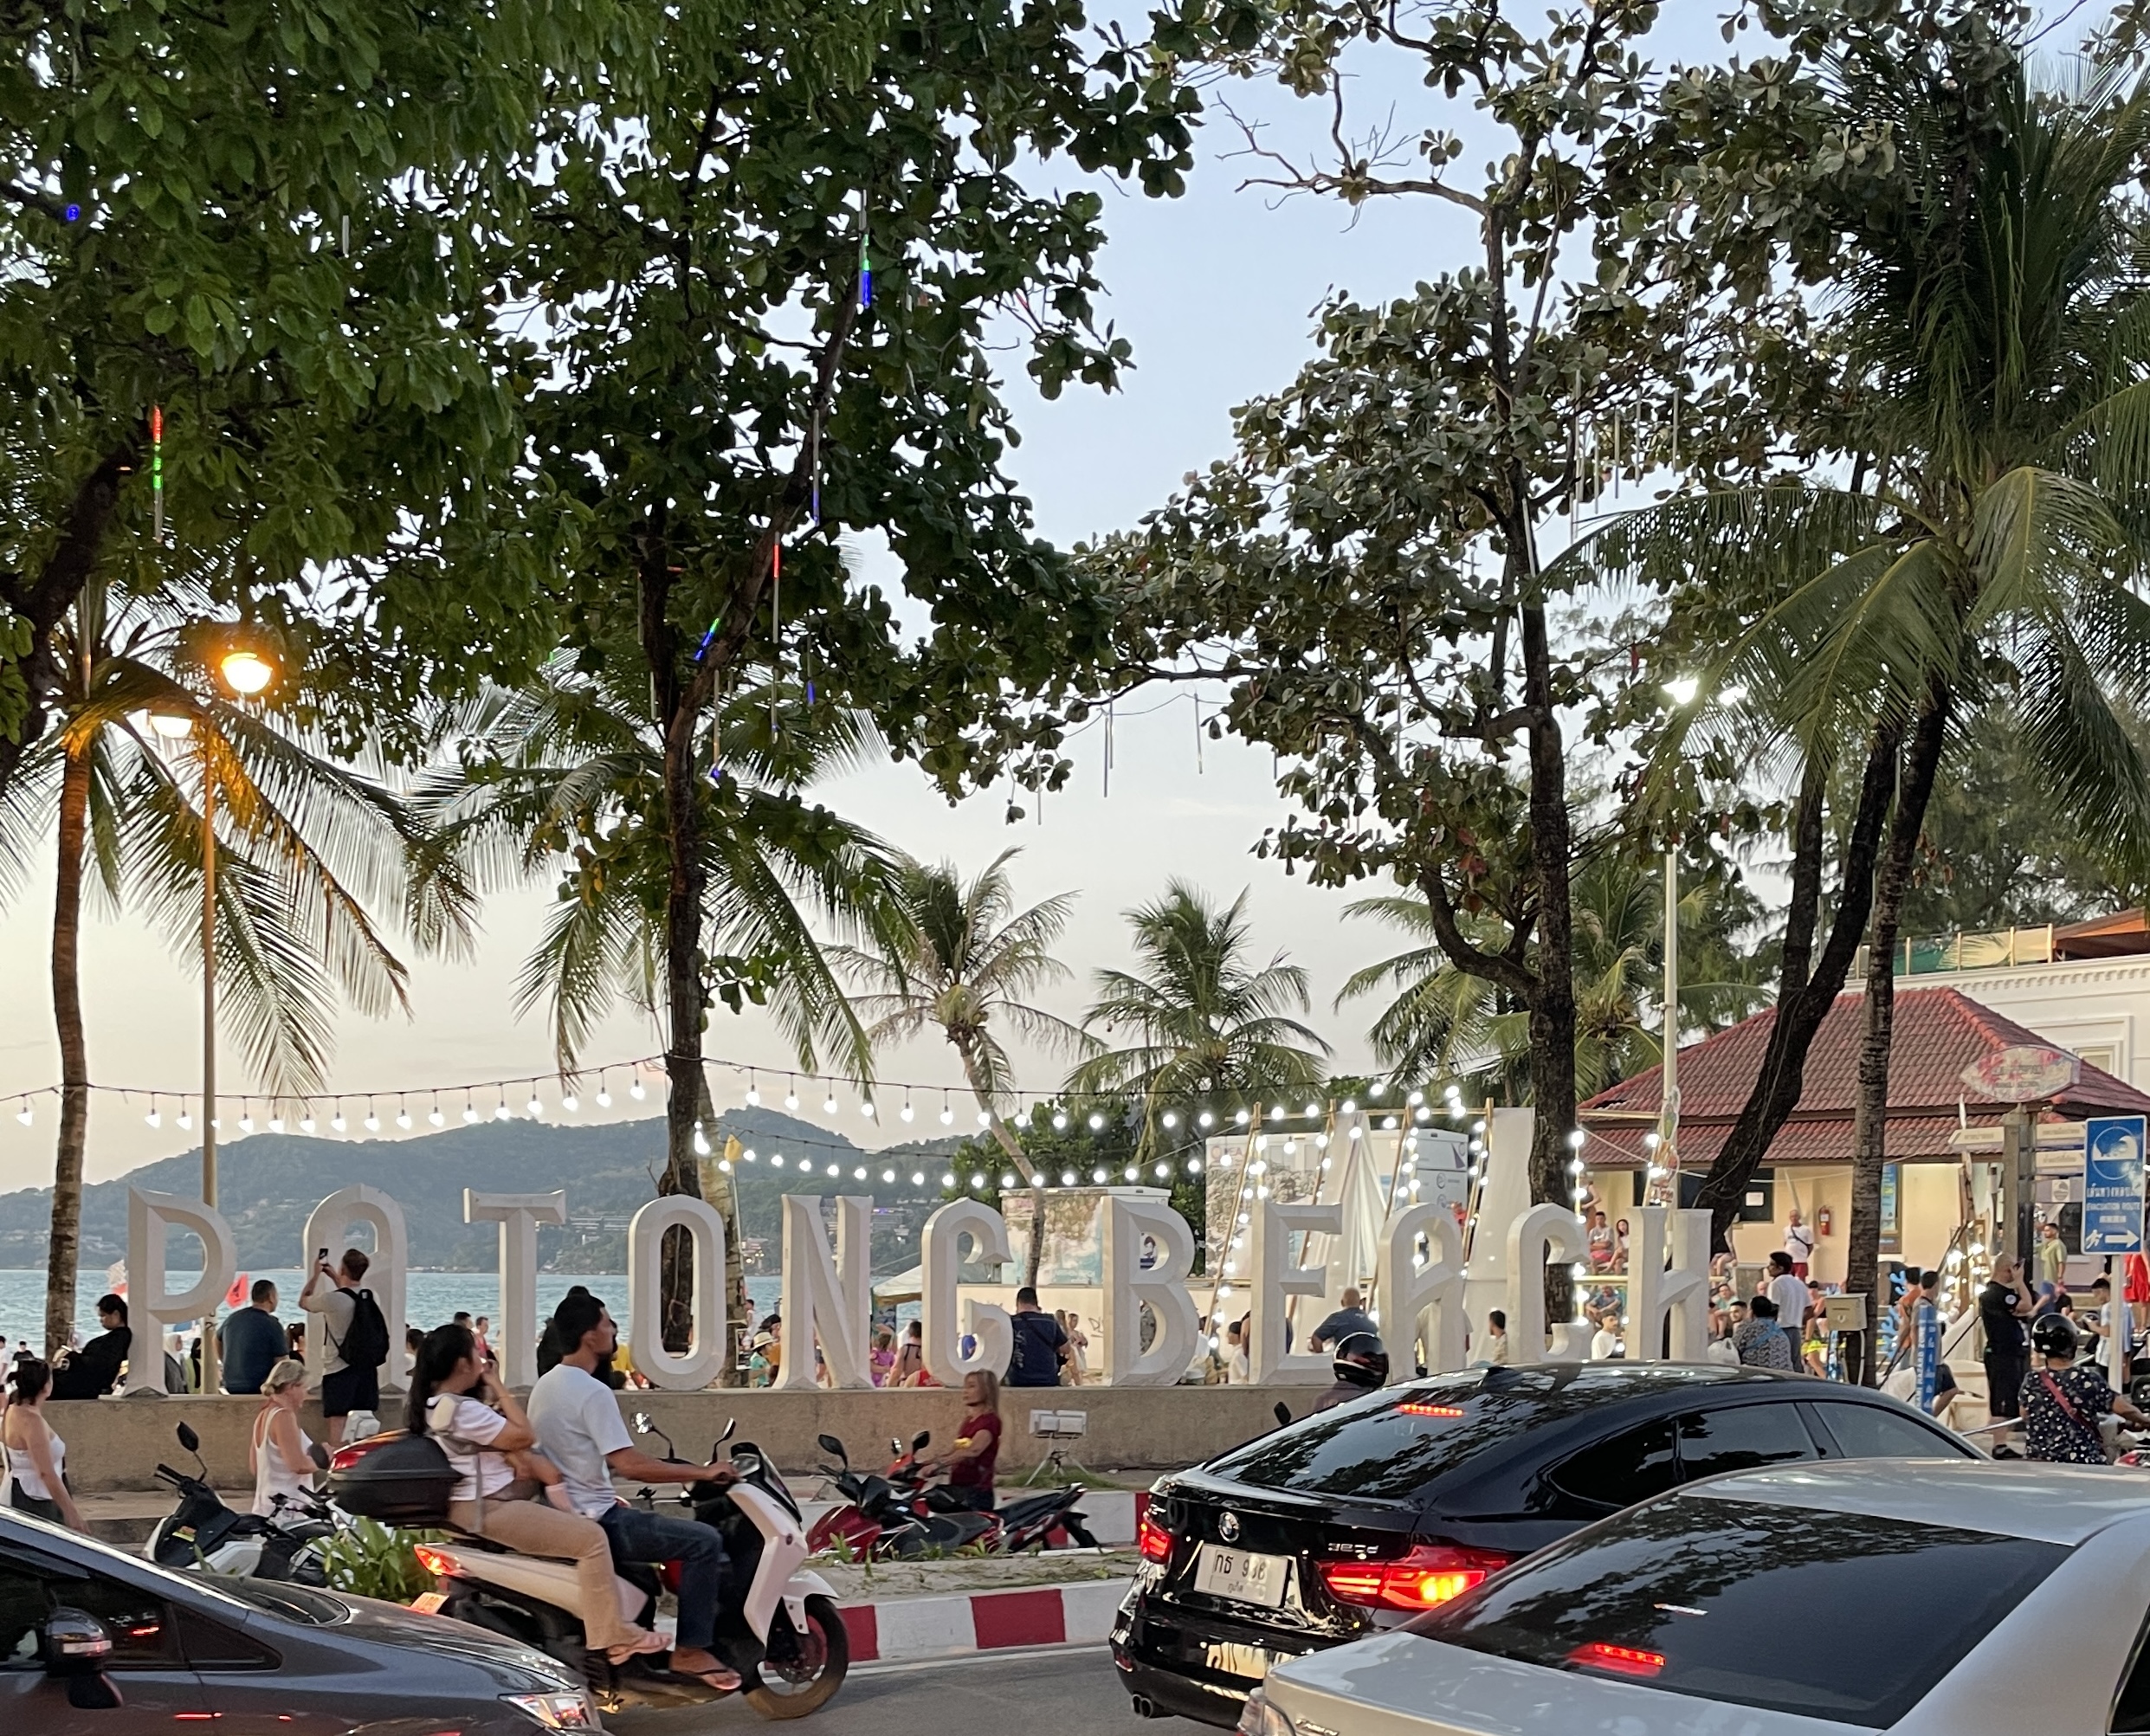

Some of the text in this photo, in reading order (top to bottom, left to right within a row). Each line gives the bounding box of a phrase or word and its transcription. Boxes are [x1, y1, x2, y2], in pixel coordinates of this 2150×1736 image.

[2086, 1202, 2140, 1211] EVACUATION ROUTE
[123, 1183, 1014, 1397] PATONG
[1101, 1195, 1714, 1389] BEACH
